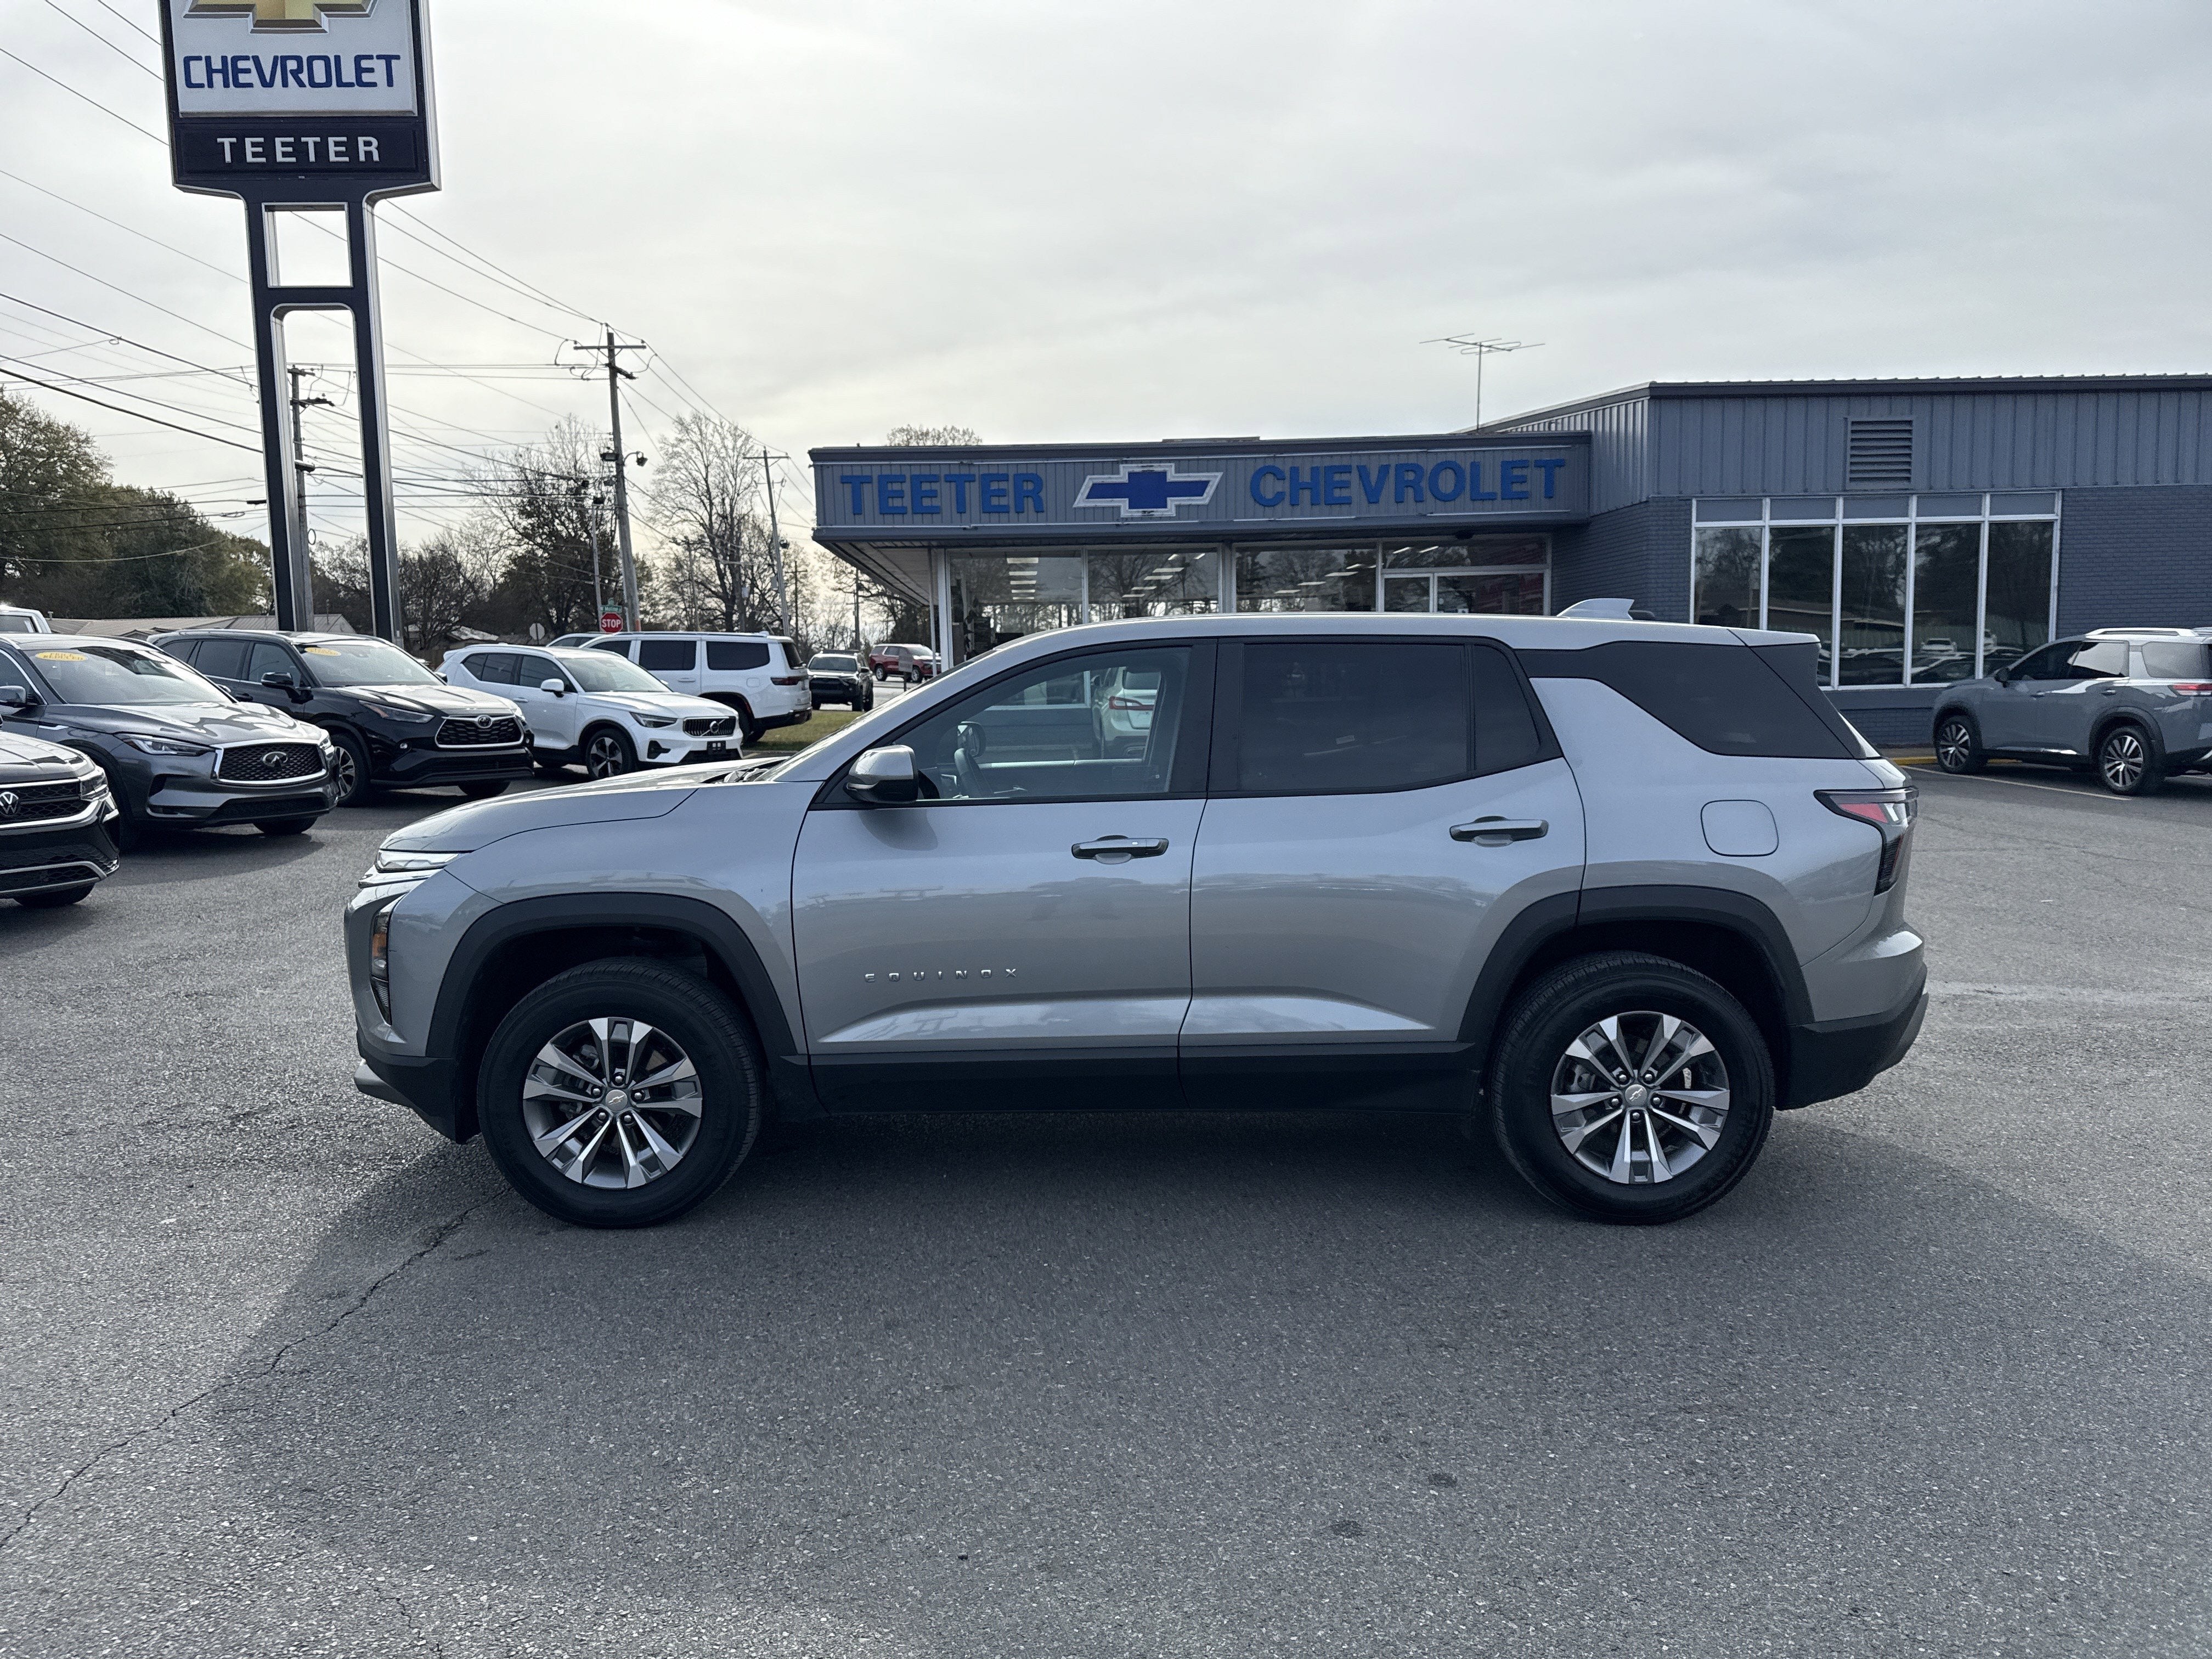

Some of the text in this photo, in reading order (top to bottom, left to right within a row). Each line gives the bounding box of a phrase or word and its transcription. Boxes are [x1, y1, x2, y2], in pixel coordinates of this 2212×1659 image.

[183, 54, 400, 88] CHEVROLET
[217, 136, 380, 163] TEETER
[840, 458, 1566, 515] TEETER CHEVROLET
[602, 619, 622, 628] STOP
[864, 968, 1017, 983] EQUINOX
